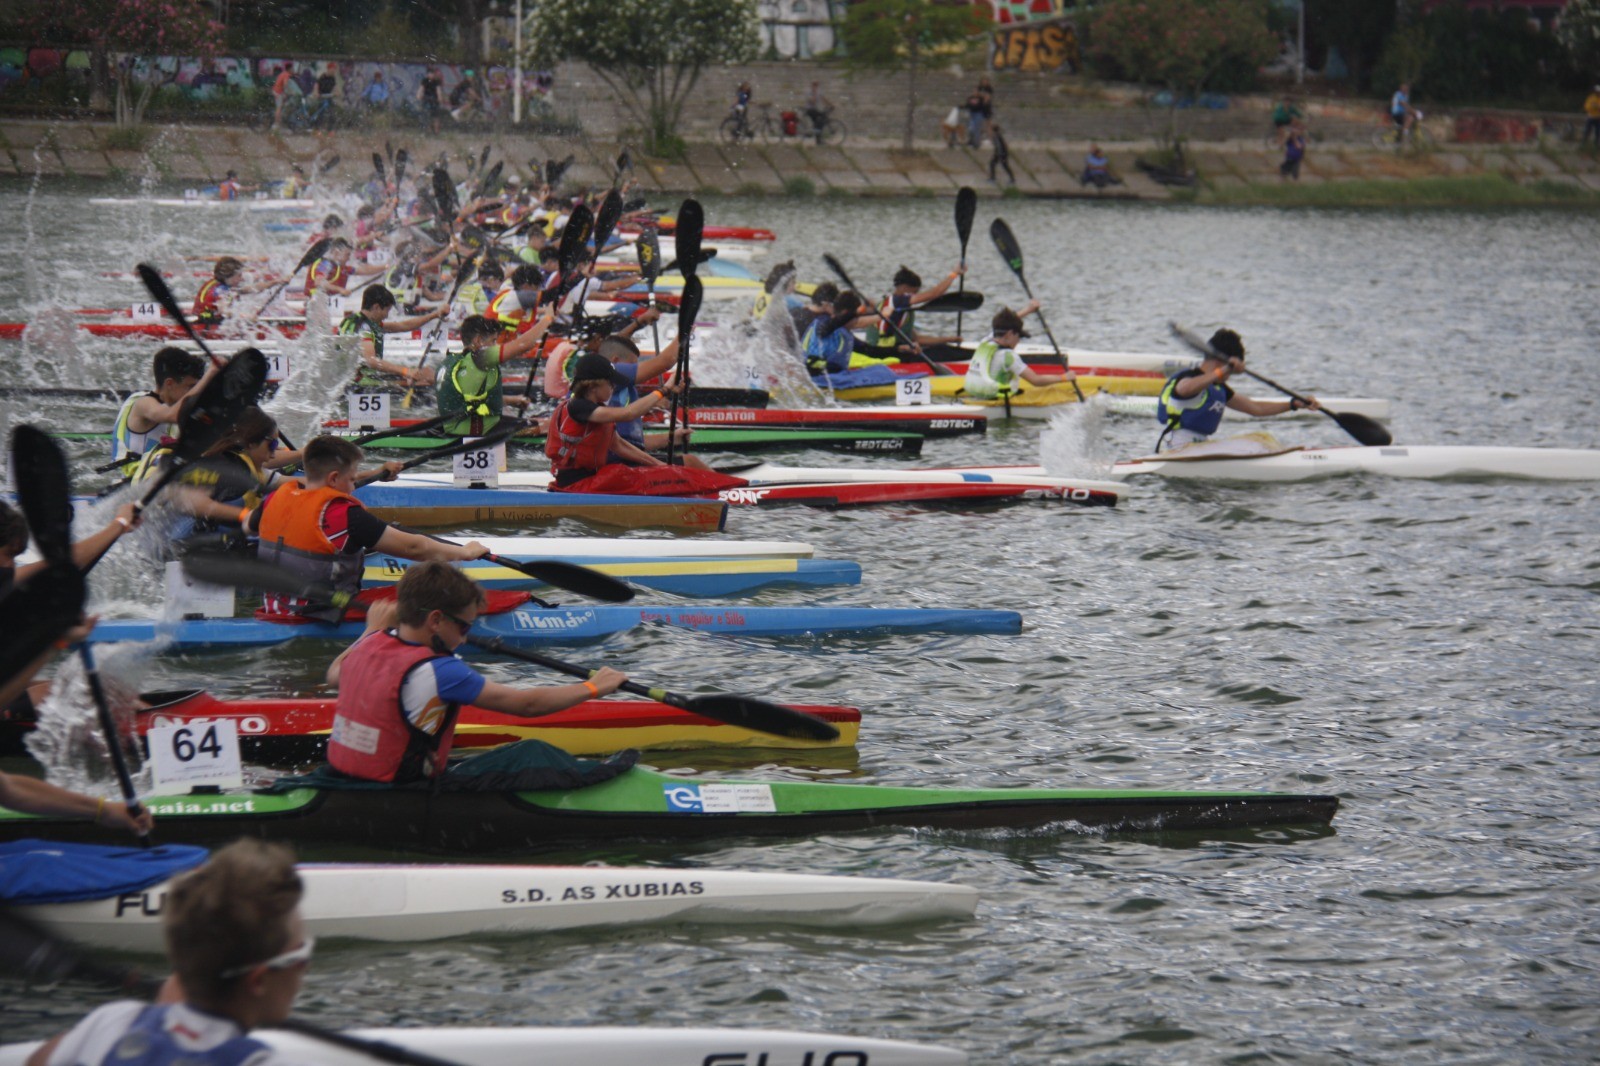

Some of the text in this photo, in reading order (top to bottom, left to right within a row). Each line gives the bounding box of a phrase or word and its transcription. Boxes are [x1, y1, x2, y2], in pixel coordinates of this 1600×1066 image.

[138, 304, 155, 316] 44
[903, 381, 923, 395] 52
[358, 395, 382, 411] 55
[695, 411, 756, 421] PREDATOR
[929, 419, 975, 429] ZEDTECH
[854, 439, 904, 449] ZEDTECH
[463, 450, 489, 469] 58
[718, 489, 771, 504] SONIC
[172, 725, 223, 762] 64
[501, 881, 705, 904] S.D. AS XUBIAS
